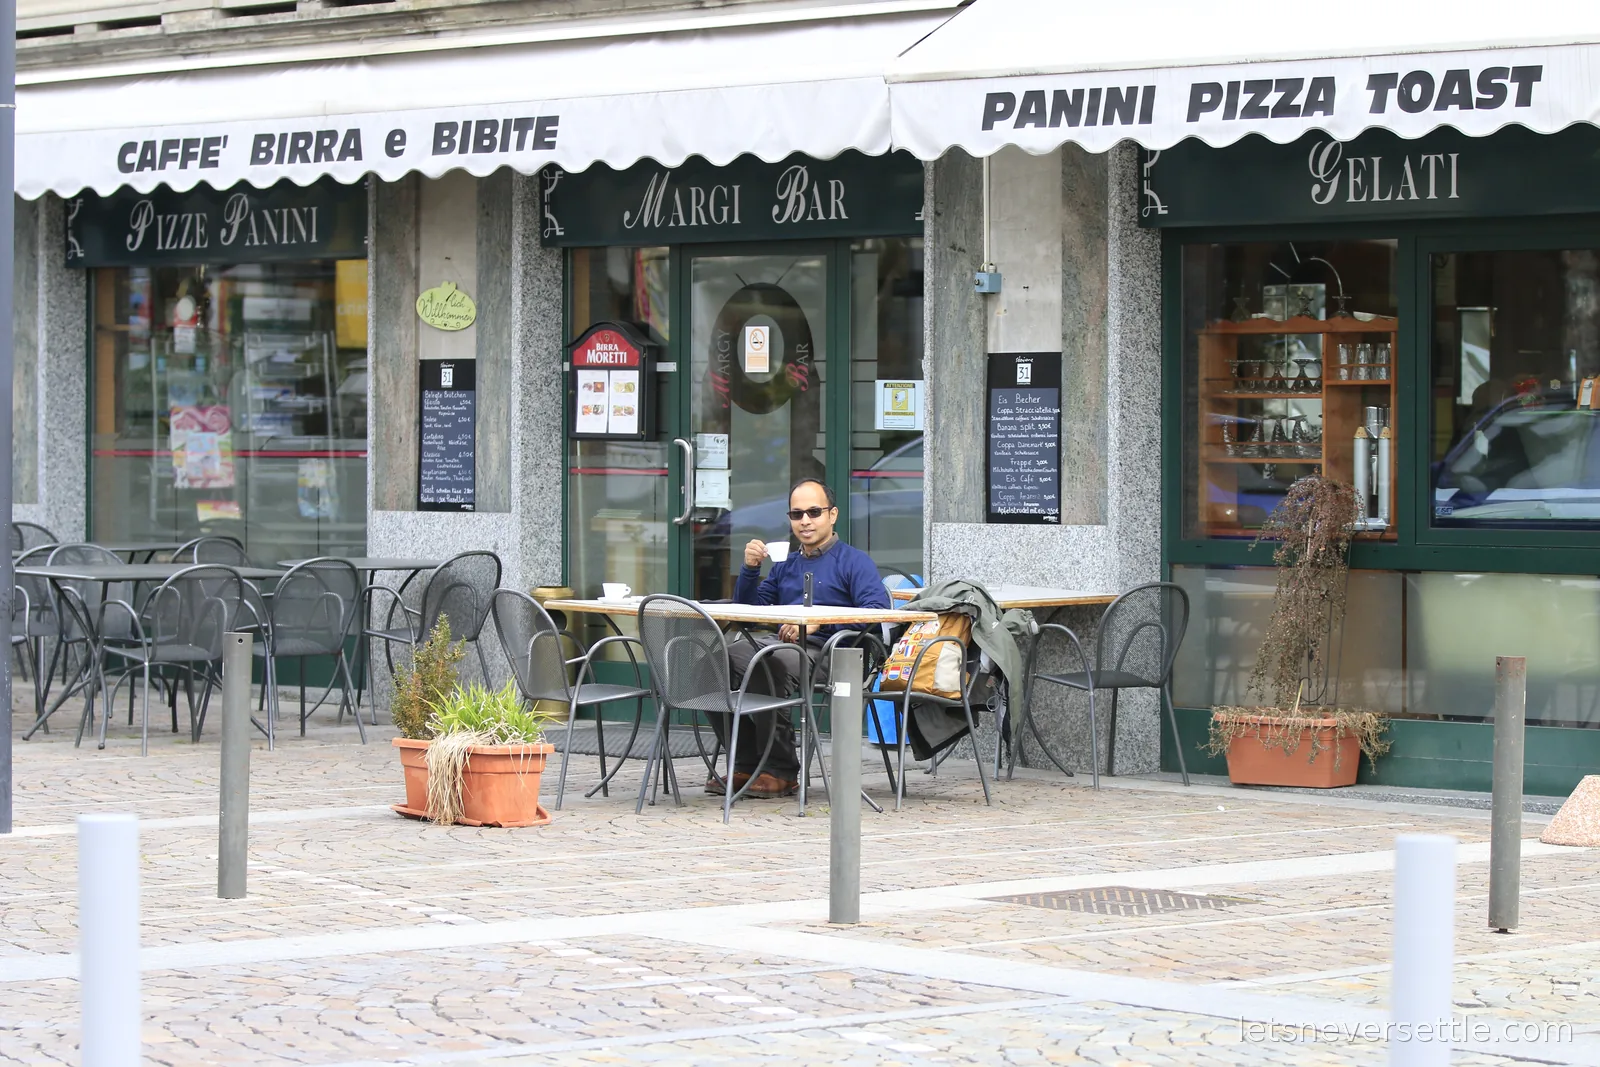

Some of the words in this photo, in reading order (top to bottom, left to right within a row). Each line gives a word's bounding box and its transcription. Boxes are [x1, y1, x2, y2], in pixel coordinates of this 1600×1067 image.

[982, 84, 1156, 131] PANINI
[1186, 76, 1337, 123] PIZZA
[1365, 64, 1543, 115] TOAST
[117, 134, 229, 174] CAFFE'
[250, 128, 364, 166] BIRRA
[385, 128, 407, 158] e
[431, 115, 560, 156] BIBITE
[1308, 140, 1460, 206] GELATI
[623, 170, 741, 229] MARGI
[772, 164, 849, 225] BAR
[126, 199, 208, 252] PIZZE
[220, 192, 318, 246] PANINI
[596, 343, 619, 351] BIRRA
[586, 349, 627, 364] MORETTI
[1018, 367, 1030, 380] 31
[998, 395, 1008, 404] Eis
[1015, 393, 1041, 404] Becher
[996, 422, 1018, 431] Banana
[996, 440, 1015, 450] Coppa
[1005, 474, 1017, 483] Eis
